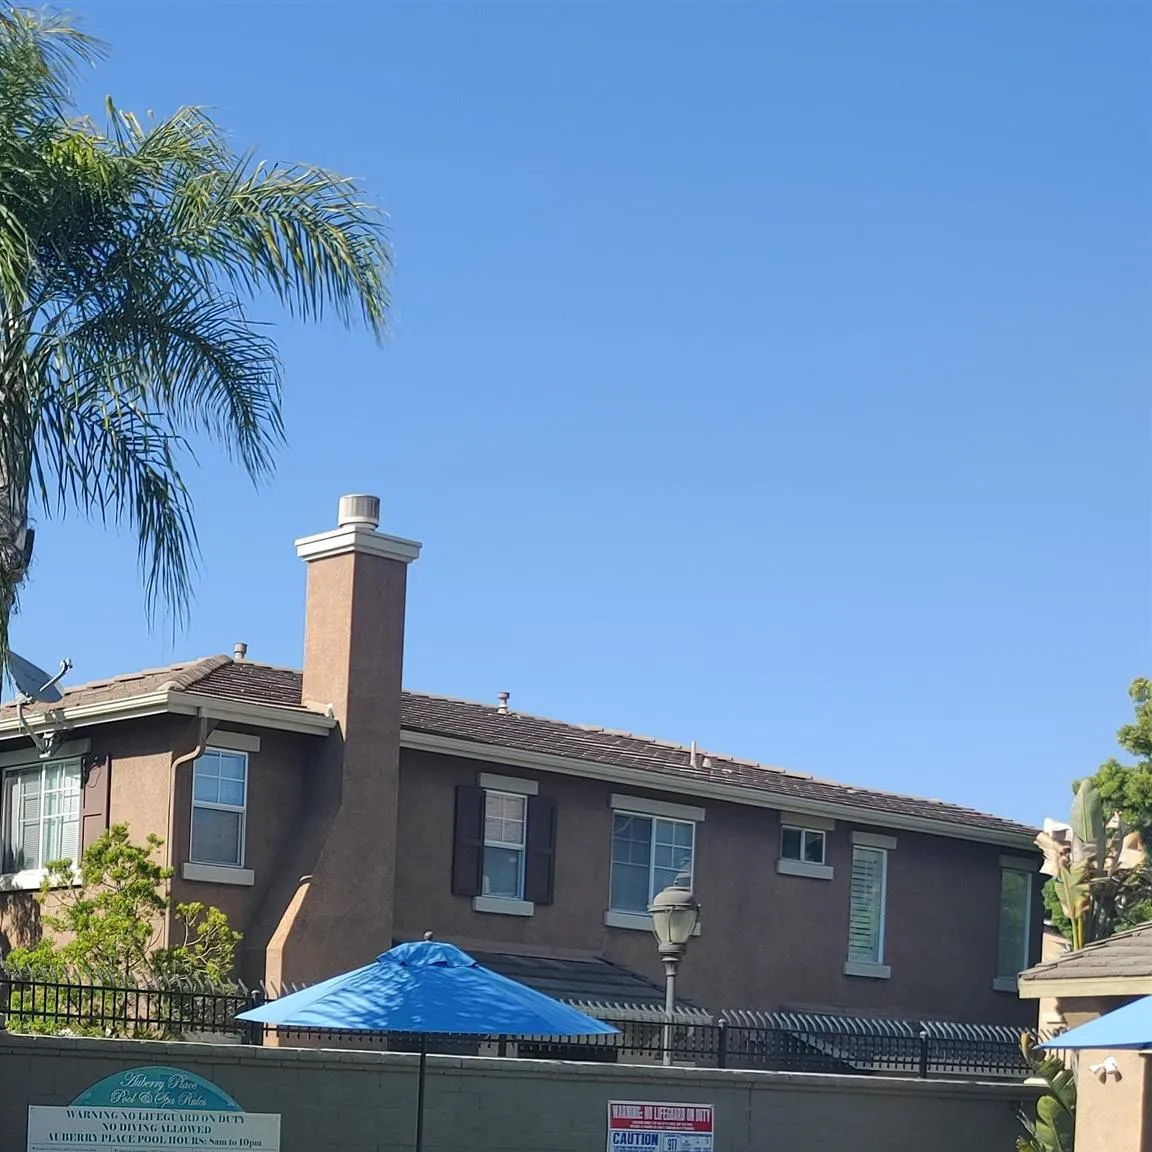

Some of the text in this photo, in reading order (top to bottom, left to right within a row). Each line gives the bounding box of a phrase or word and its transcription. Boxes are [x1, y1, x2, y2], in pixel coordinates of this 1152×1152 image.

[120, 1071, 198, 1093] Auberry Place
[110, 1089, 207, 1108] Pool & Spa Rules
[65, 1110, 245, 1124] WARNING NO LIFEGUARD ON DUTY
[102, 1122, 212, 1134] NO DIVING ALLOWED
[48, 1132, 262, 1148] AUBERRY PLACE POOL HOURS: 8am to 10pm
[612, 1132, 658, 1146] CAUTION
[667, 1138, 677, 1151] 911
